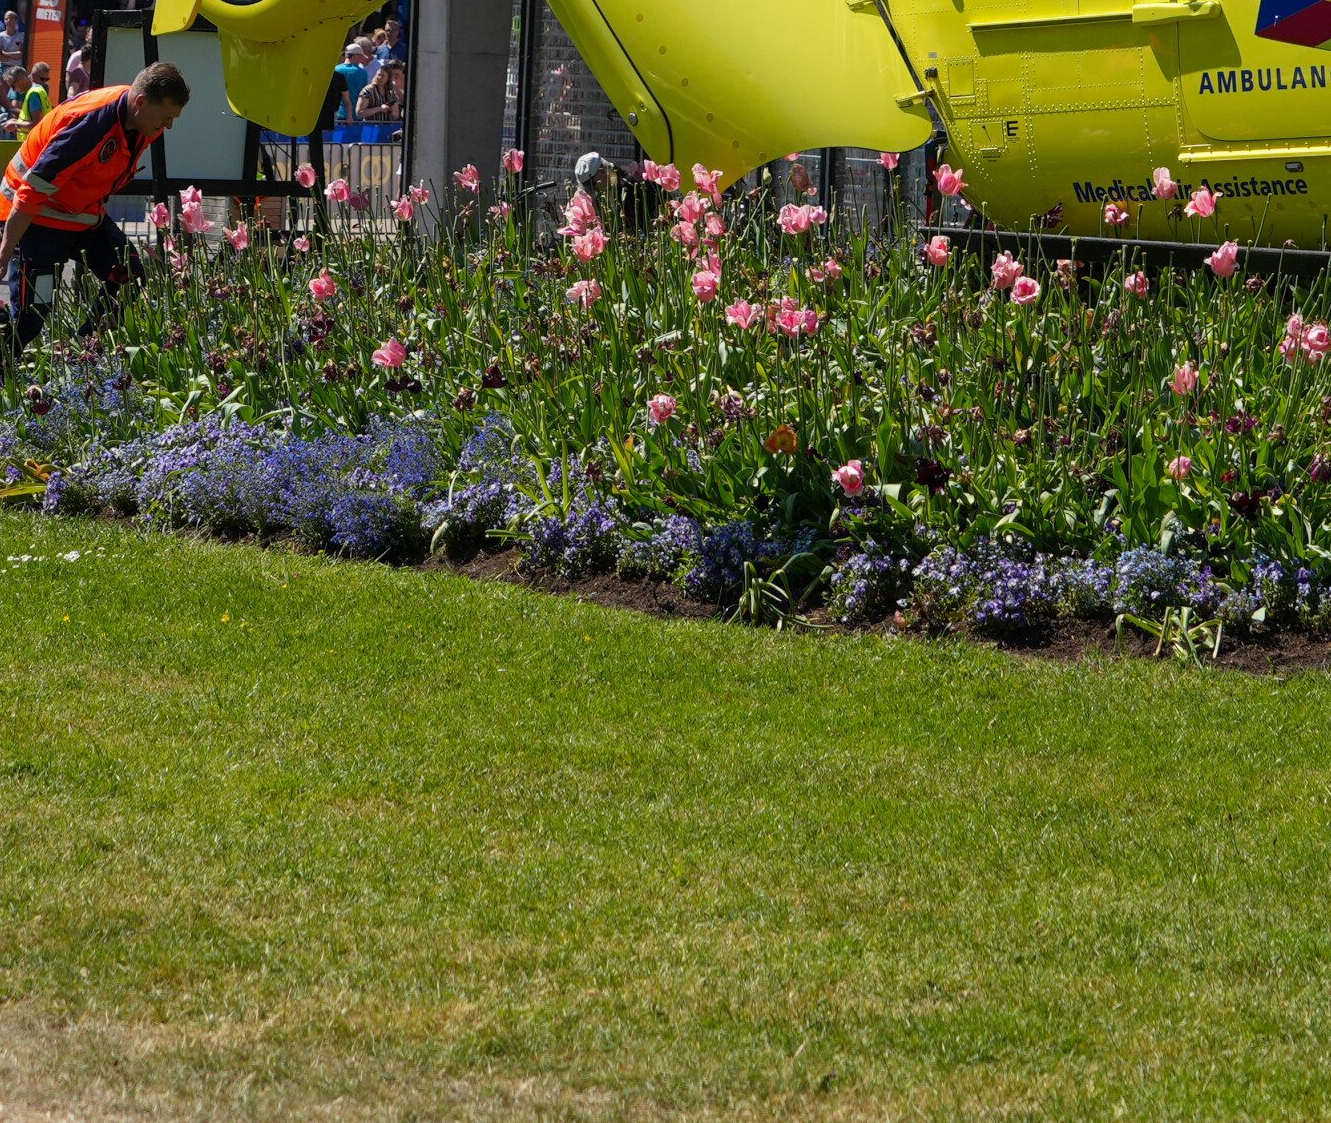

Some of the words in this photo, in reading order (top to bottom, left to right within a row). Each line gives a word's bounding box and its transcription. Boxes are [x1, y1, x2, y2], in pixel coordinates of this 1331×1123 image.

[36, 8, 62, 21] METER
[1072, 178, 1156, 203] Medical
[1200, 175, 1309, 199] Assistance
